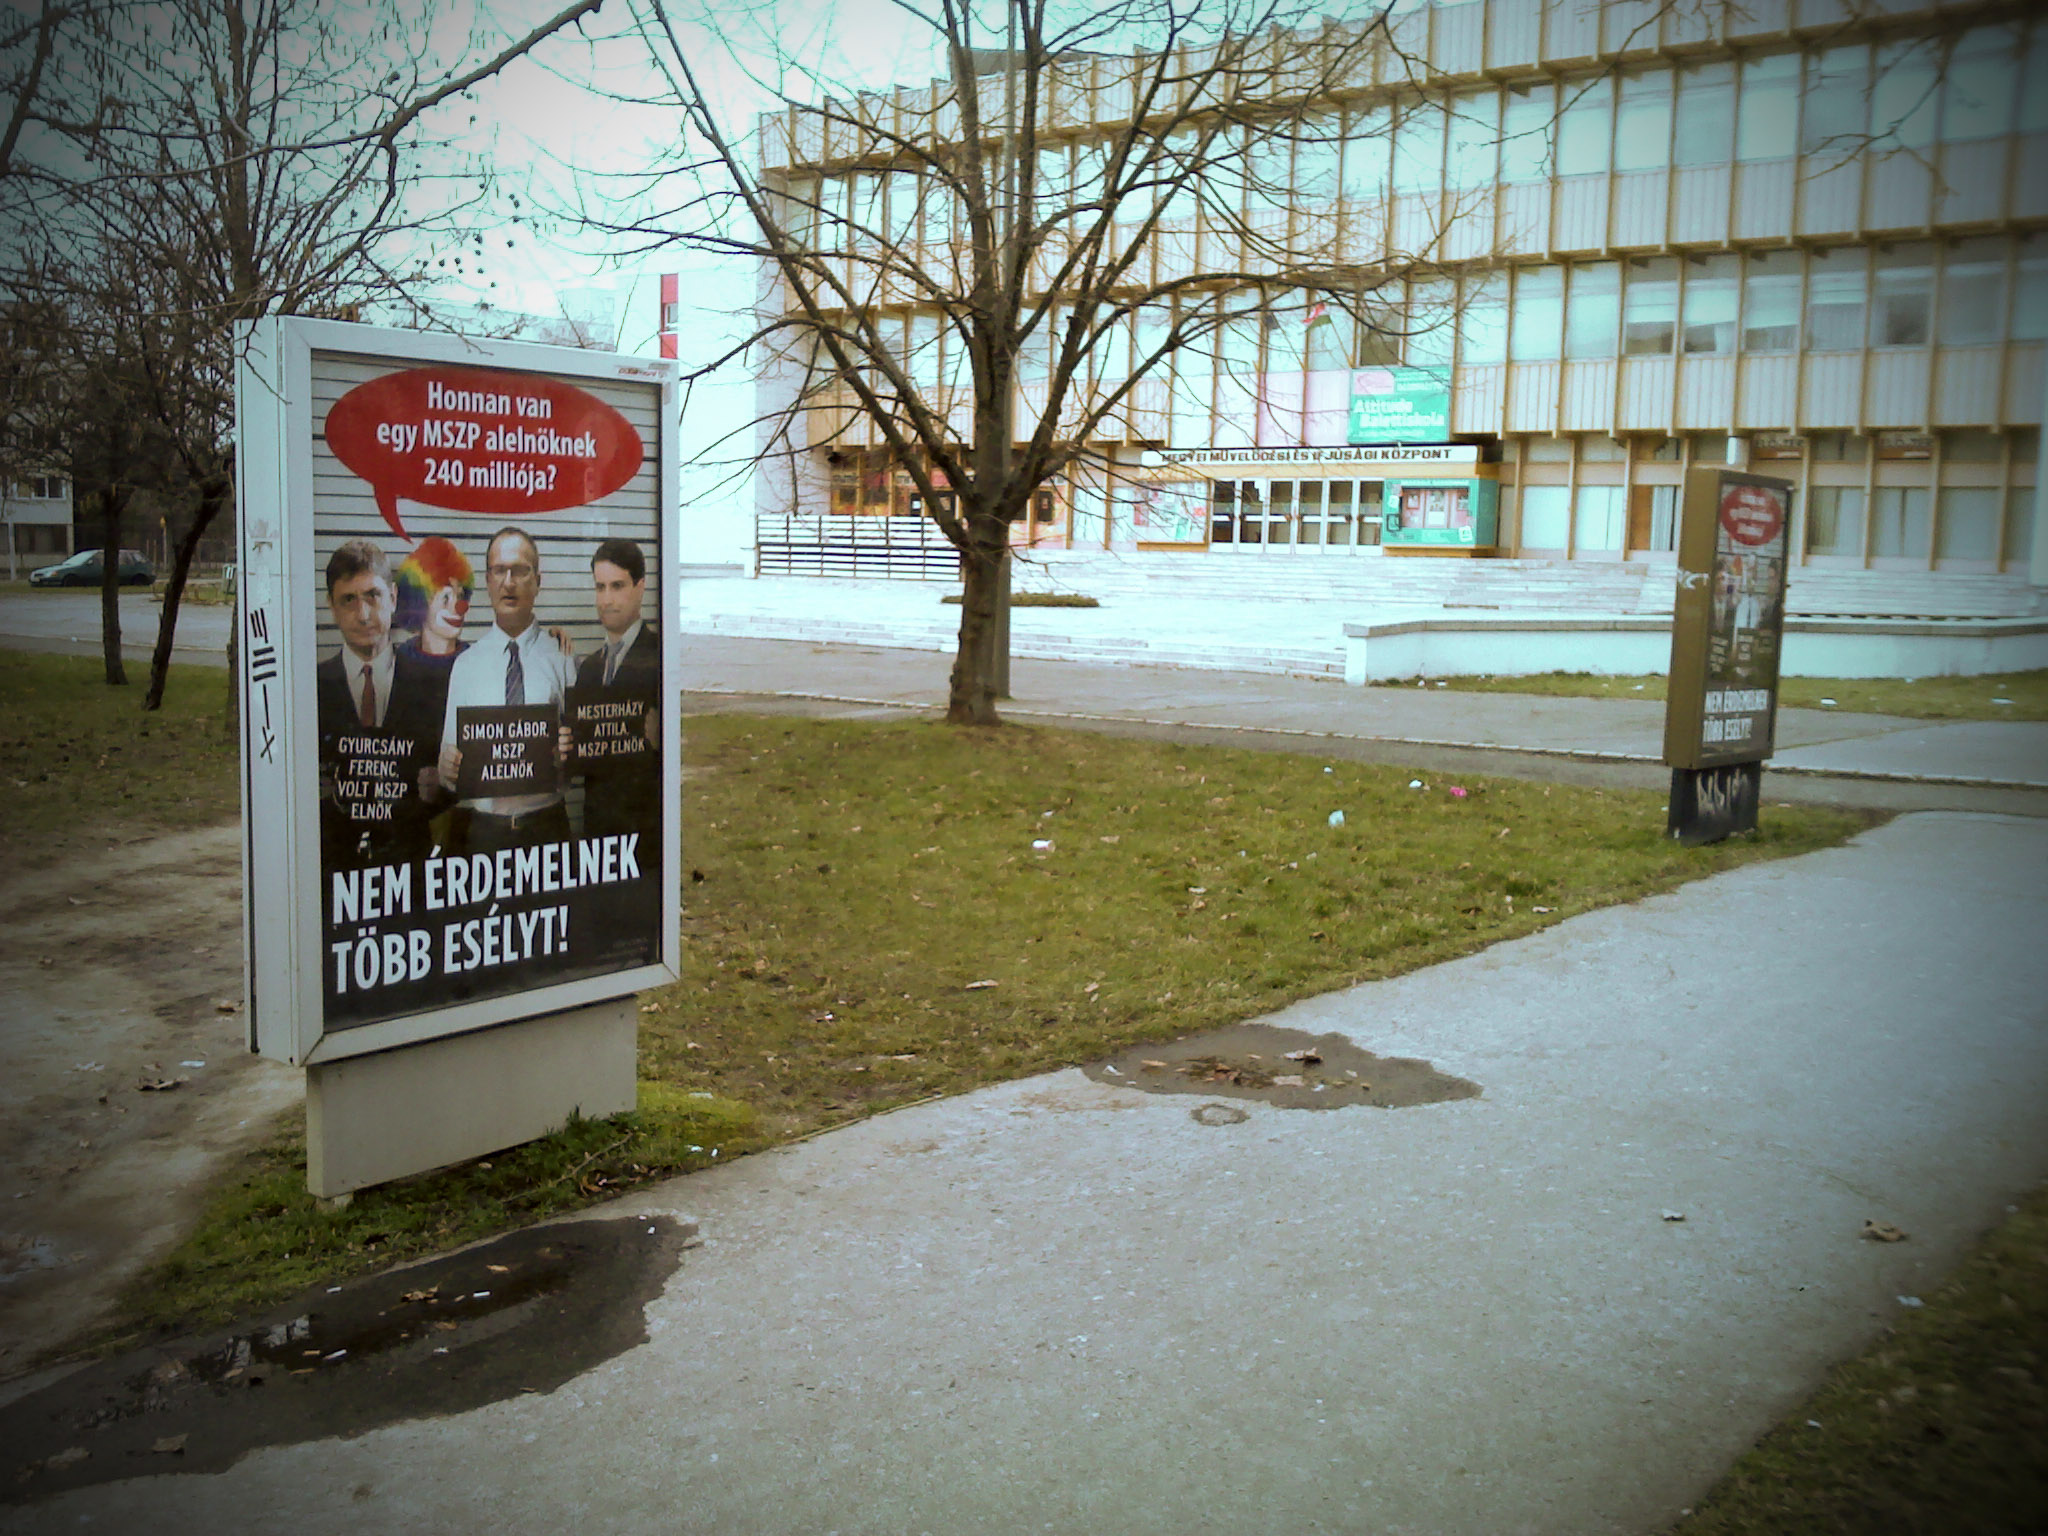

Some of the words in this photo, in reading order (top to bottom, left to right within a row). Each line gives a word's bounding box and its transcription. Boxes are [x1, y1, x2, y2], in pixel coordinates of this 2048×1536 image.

[427, 381, 511, 416] Honnan
[515, 396, 552, 420] van
[376, 424, 418, 454] egy
[422, 420, 481, 450] MSZP
[485, 425, 597, 458] alelnöknek
[1381, 446, 1452, 460] KÖZPONT
[423, 457, 465, 487] 240
[469, 463, 557, 497] milliója?
[577, 701, 645, 721] MESTERHÁZY
[462, 722, 504, 741] SIMON
[338, 736, 414, 757] GYURCSÁNY
[492, 743, 525, 760] MSZP
[578, 741, 609, 758] MSZP
[611, 736, 645, 754] ELNÖK
[481, 761, 535, 781] ALELNÖK
[337, 780, 368, 798] VOLT
[374, 782, 408, 799] MSZP
[351, 800, 393, 820] ELNÖK
[332, 862, 412, 924] NEM
[424, 833, 640, 910] ÉRDEMELNEK
[331, 927, 432, 995] TÖBB
[443, 903, 569, 975] ESÉLYT!
